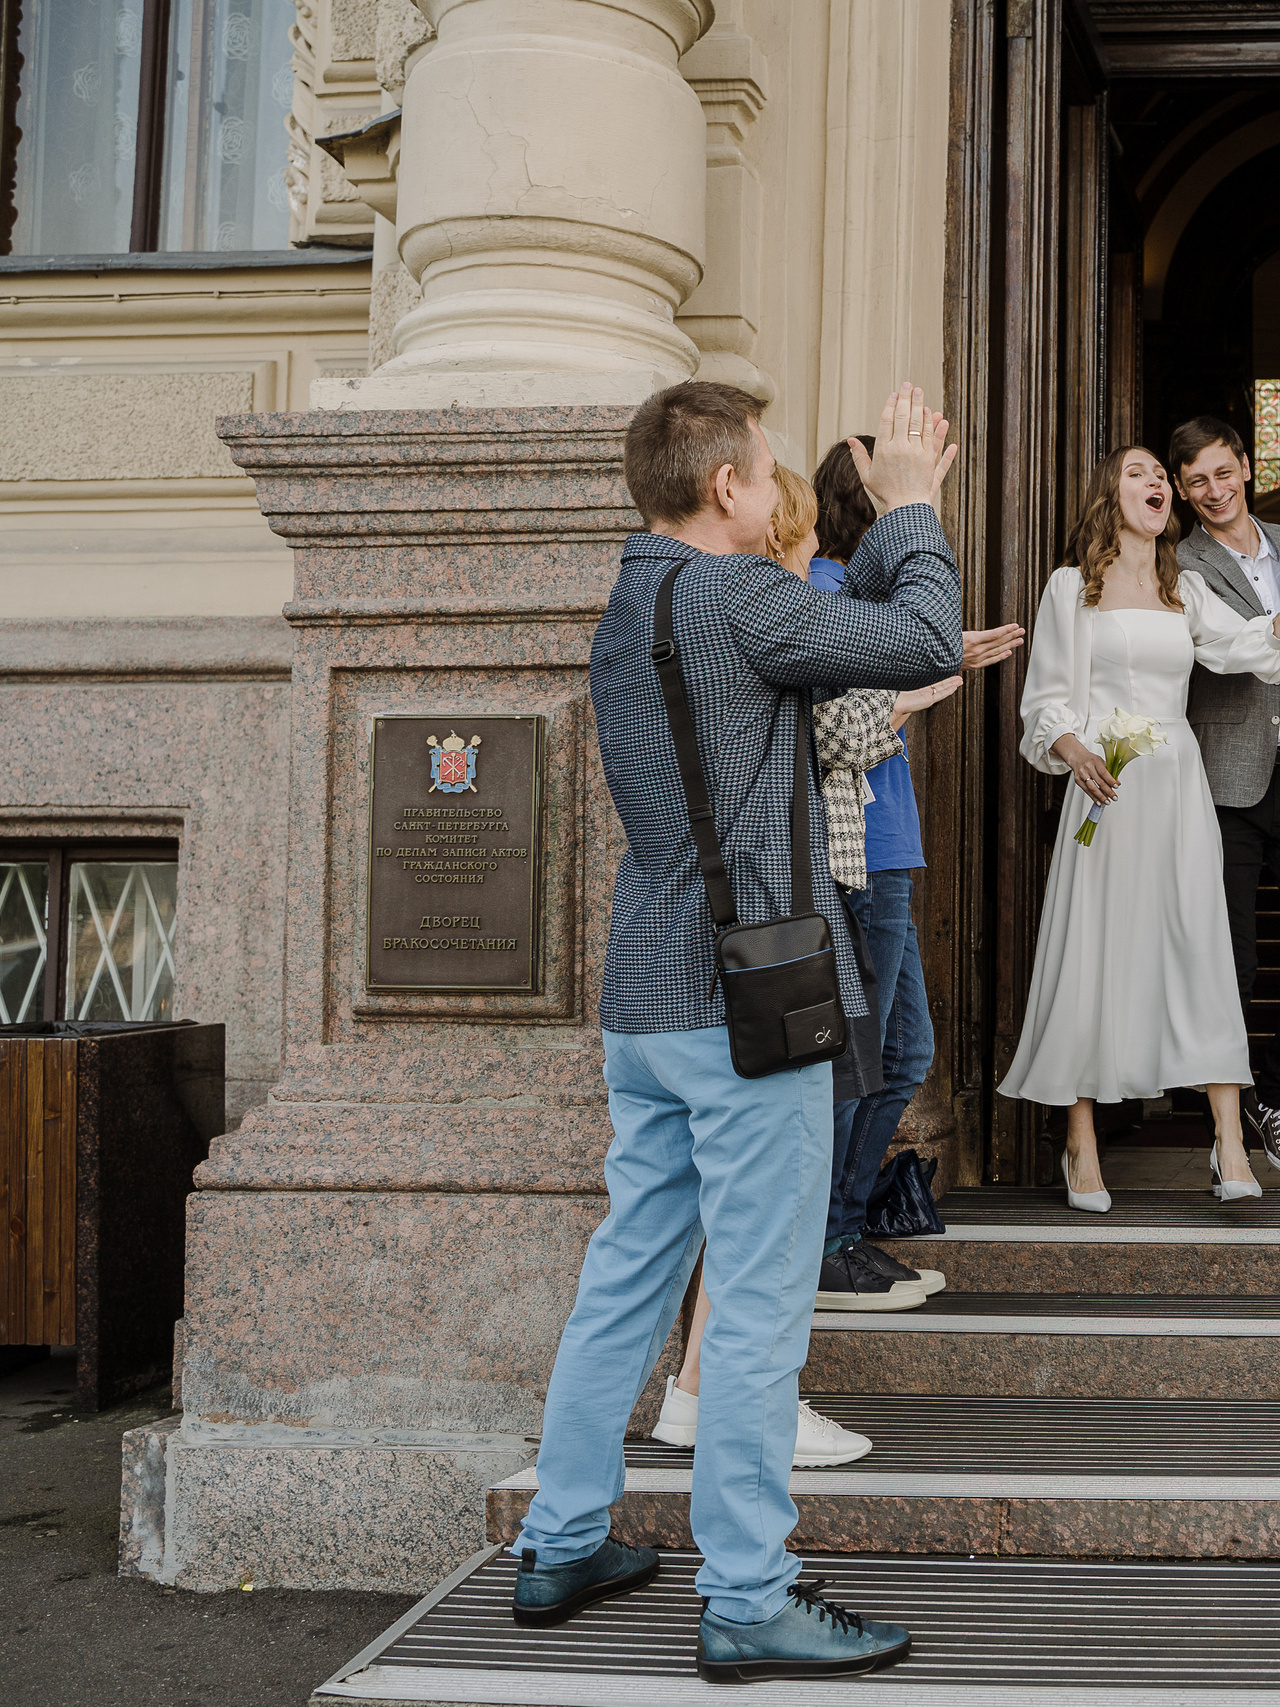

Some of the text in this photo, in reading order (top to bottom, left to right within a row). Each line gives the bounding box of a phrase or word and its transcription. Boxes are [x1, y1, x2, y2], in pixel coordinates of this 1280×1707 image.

[403, 808, 502, 818] ПРАВИТЕЛЬСТВО
[394, 821, 509, 832] САНКТ-ПЕТЕРБУРГА
[425, 834, 478, 844] КОМИТЕТ
[376, 847, 528, 858] ПО ДЕЛАМ ЗАПИСИ АКТОВ
[403, 861, 498, 871] ГРАЖДАНСКОГО
[415, 874, 484, 884] СОСТОЯНИЯ
[420, 916, 481, 930] ДВОРЕЦ
[383, 938, 517, 950] БРАКОСОЧЕТАНИЯ
